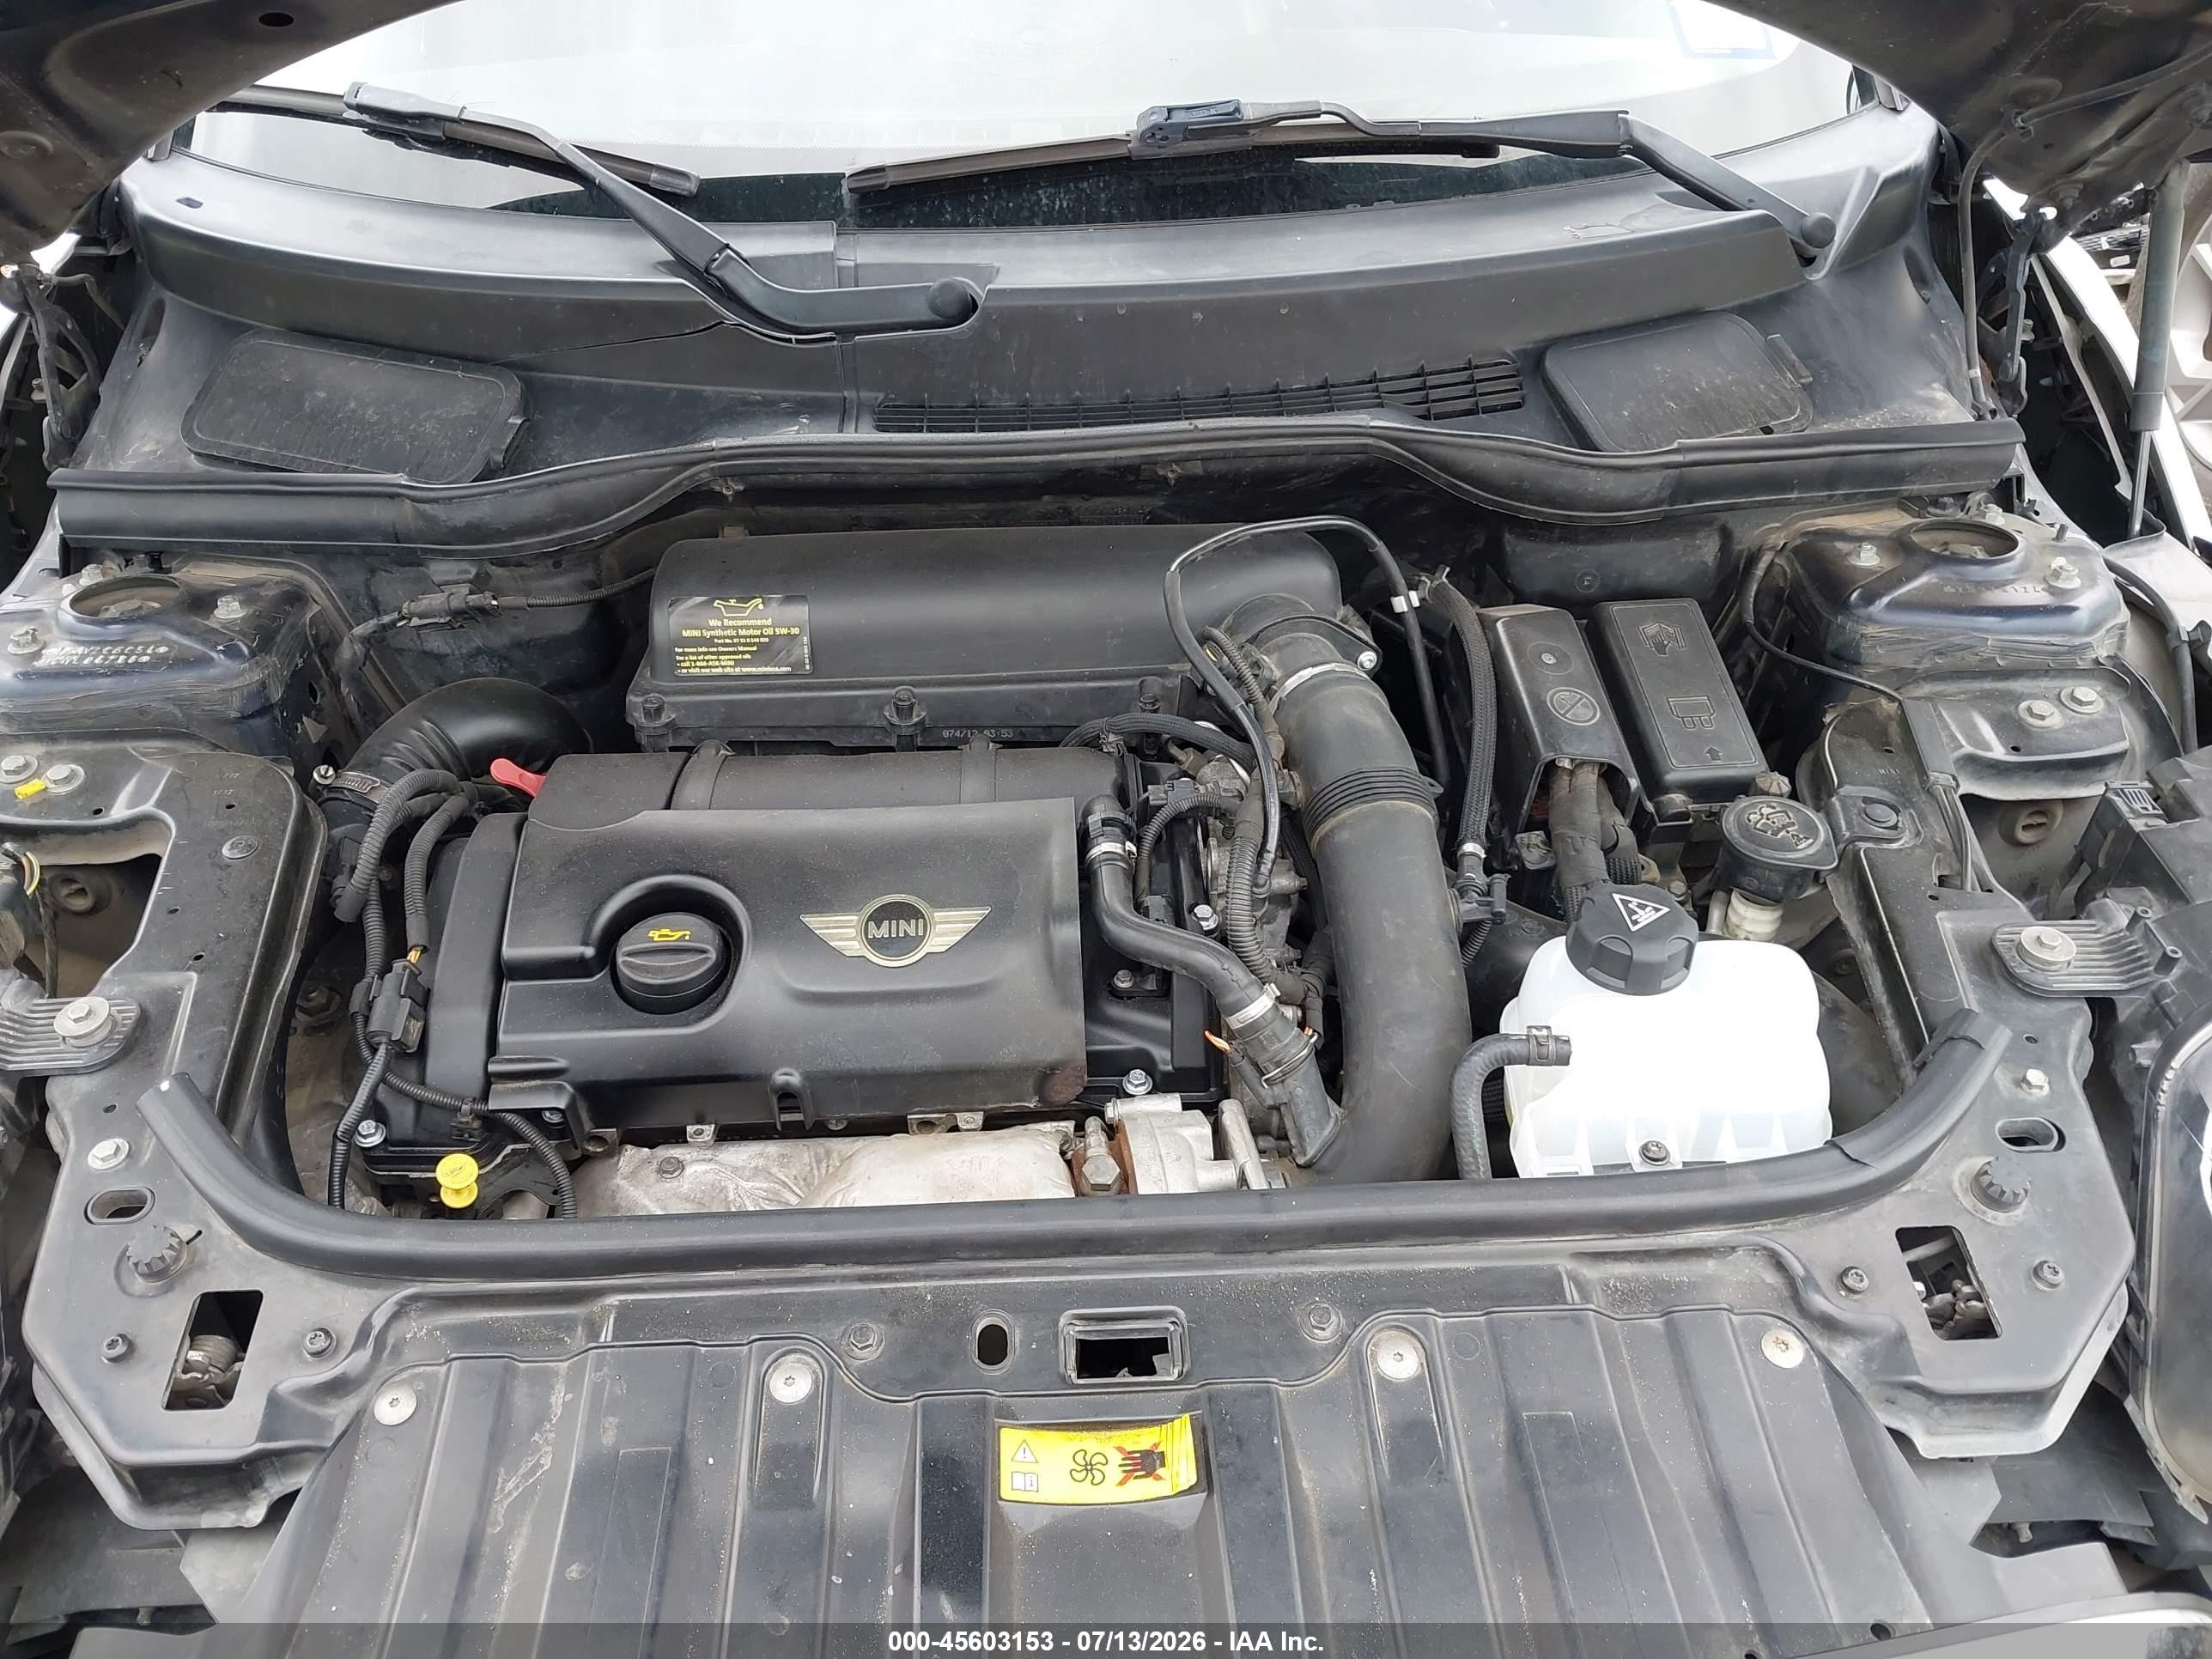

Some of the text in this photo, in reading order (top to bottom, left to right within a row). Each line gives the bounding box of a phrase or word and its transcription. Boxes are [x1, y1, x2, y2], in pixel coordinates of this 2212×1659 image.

[708, 617, 772, 627] We Recommend
[682, 626, 800, 639] MINI Synthetic Motor Oil 5W-30
[867, 918, 924, 939] MINI
